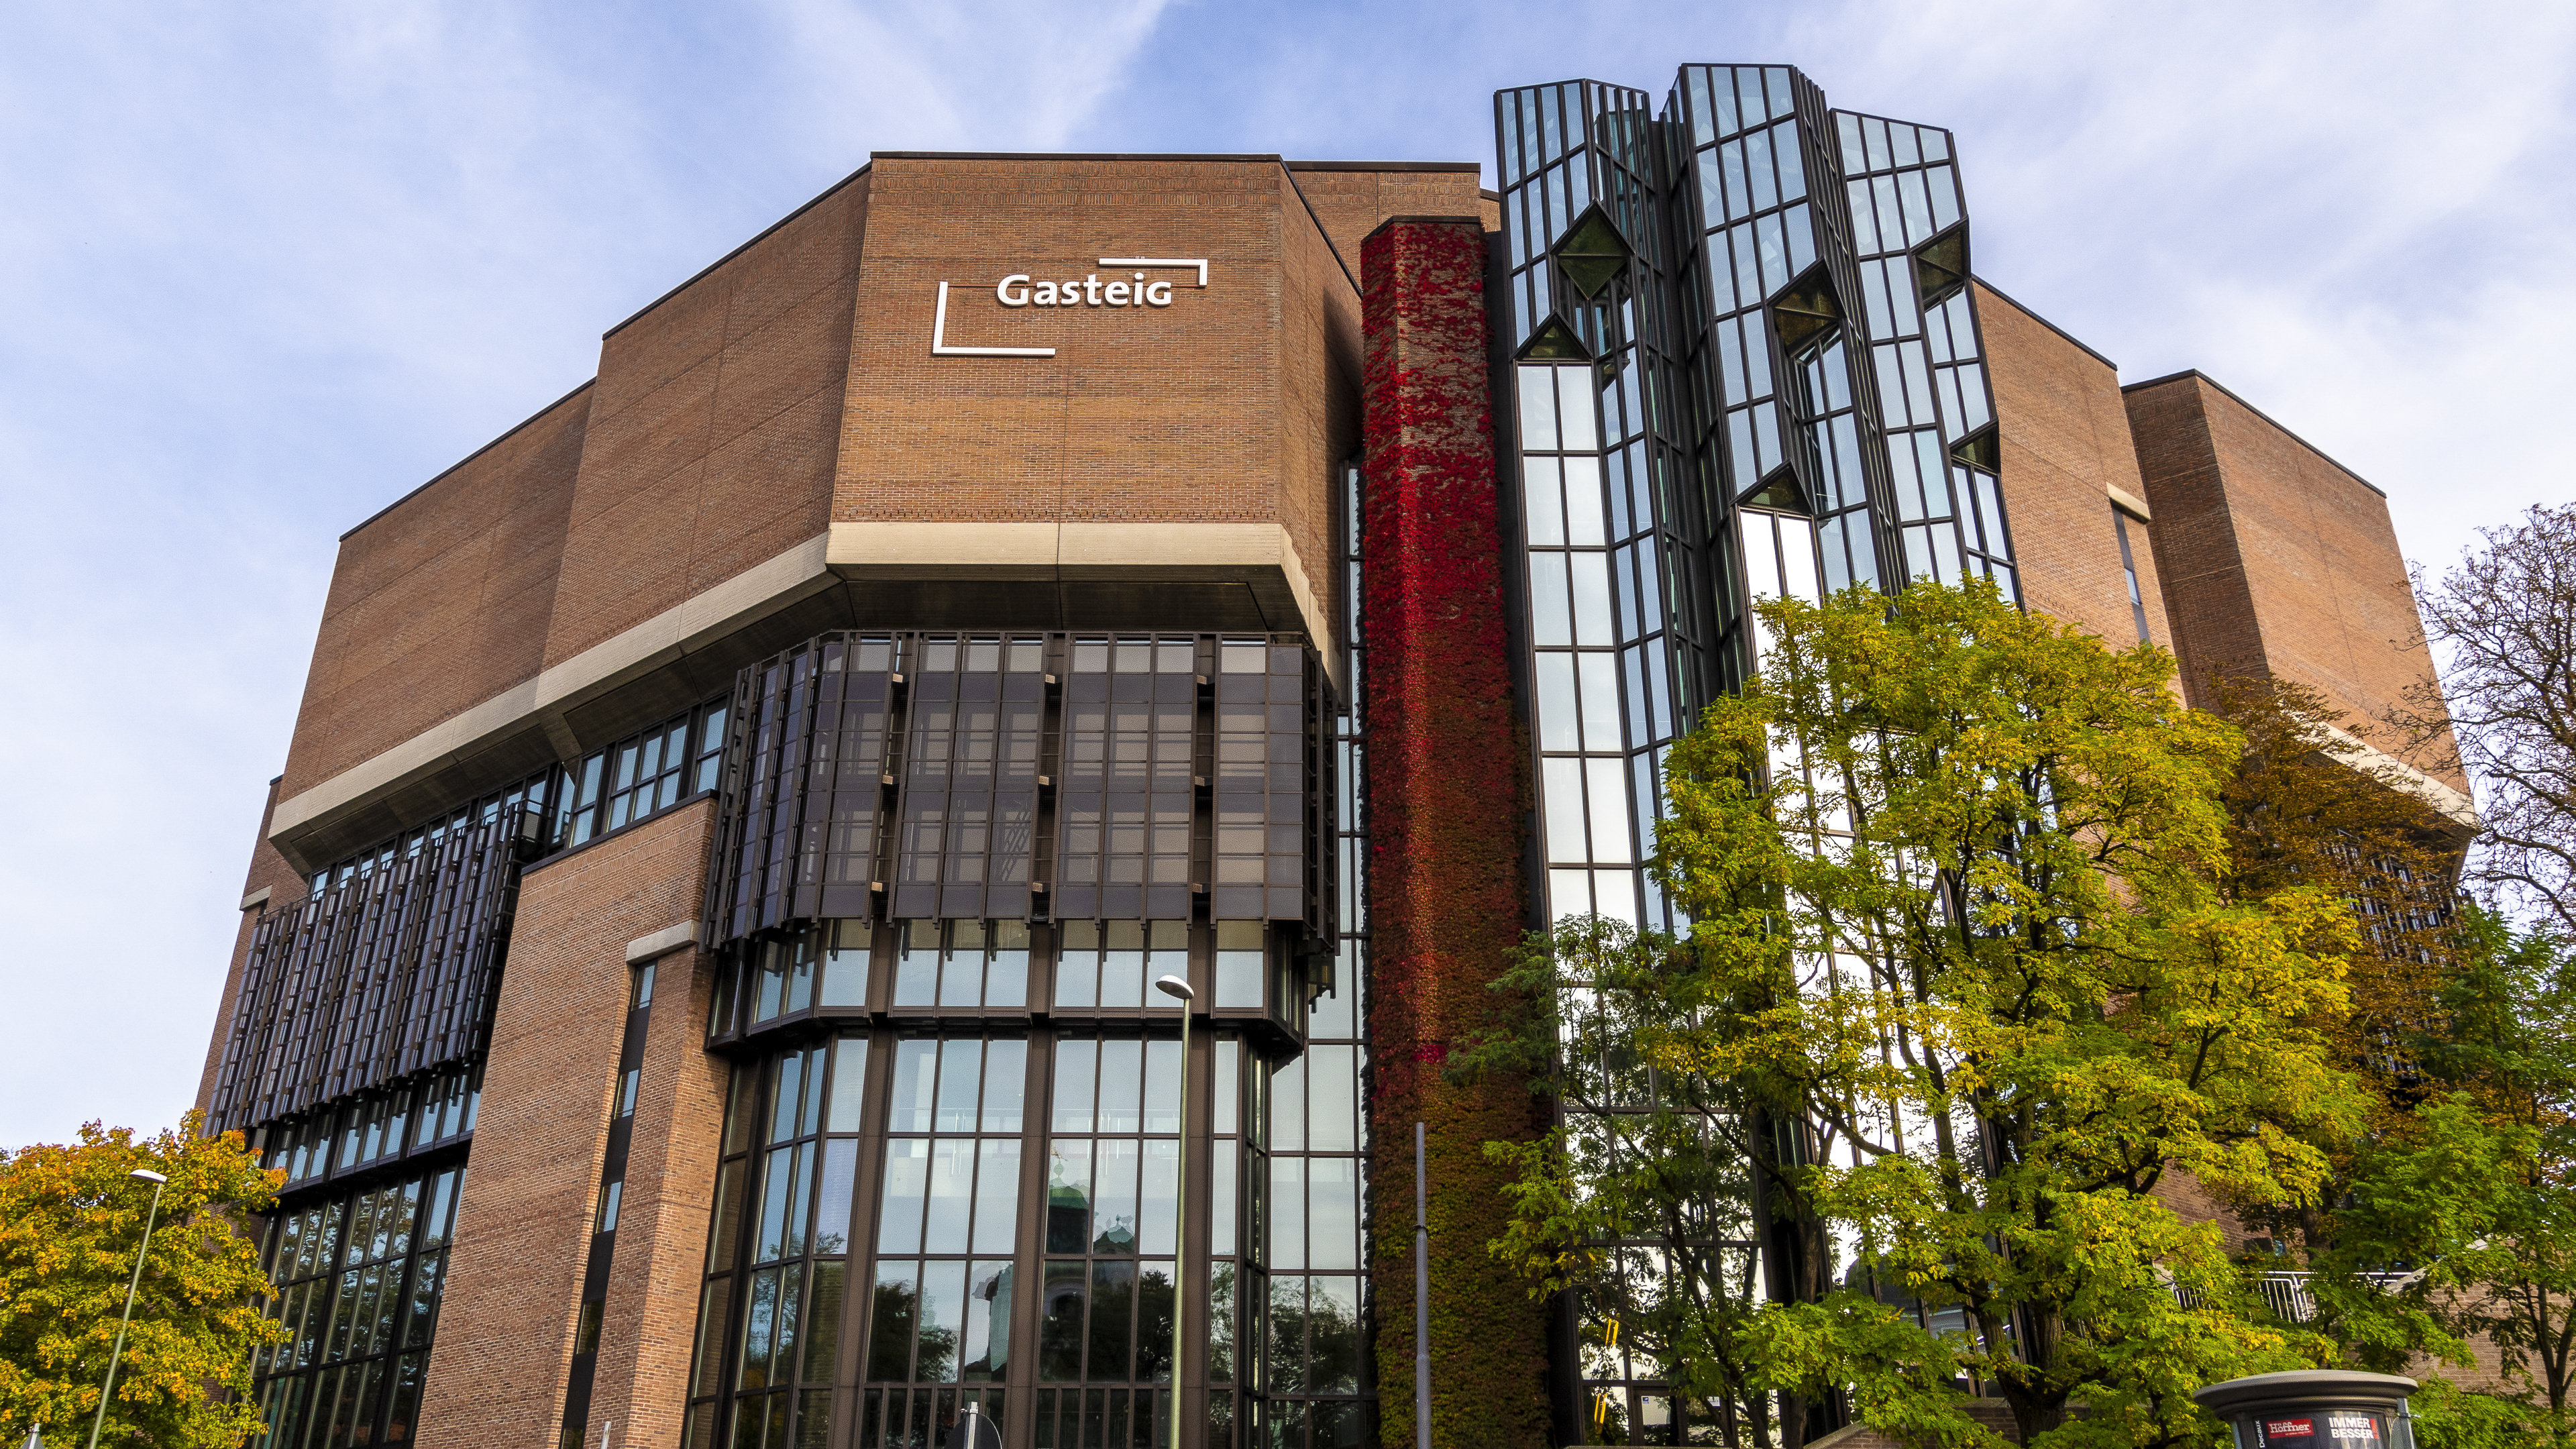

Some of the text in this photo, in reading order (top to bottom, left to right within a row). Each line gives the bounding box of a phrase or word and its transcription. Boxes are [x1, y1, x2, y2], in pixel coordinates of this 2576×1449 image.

[2269, 1421, 2310, 1433] Höffner
[2328, 1417, 2371, 1428] IMMER
[2255, 1420, 2265, 1448] Decaux
